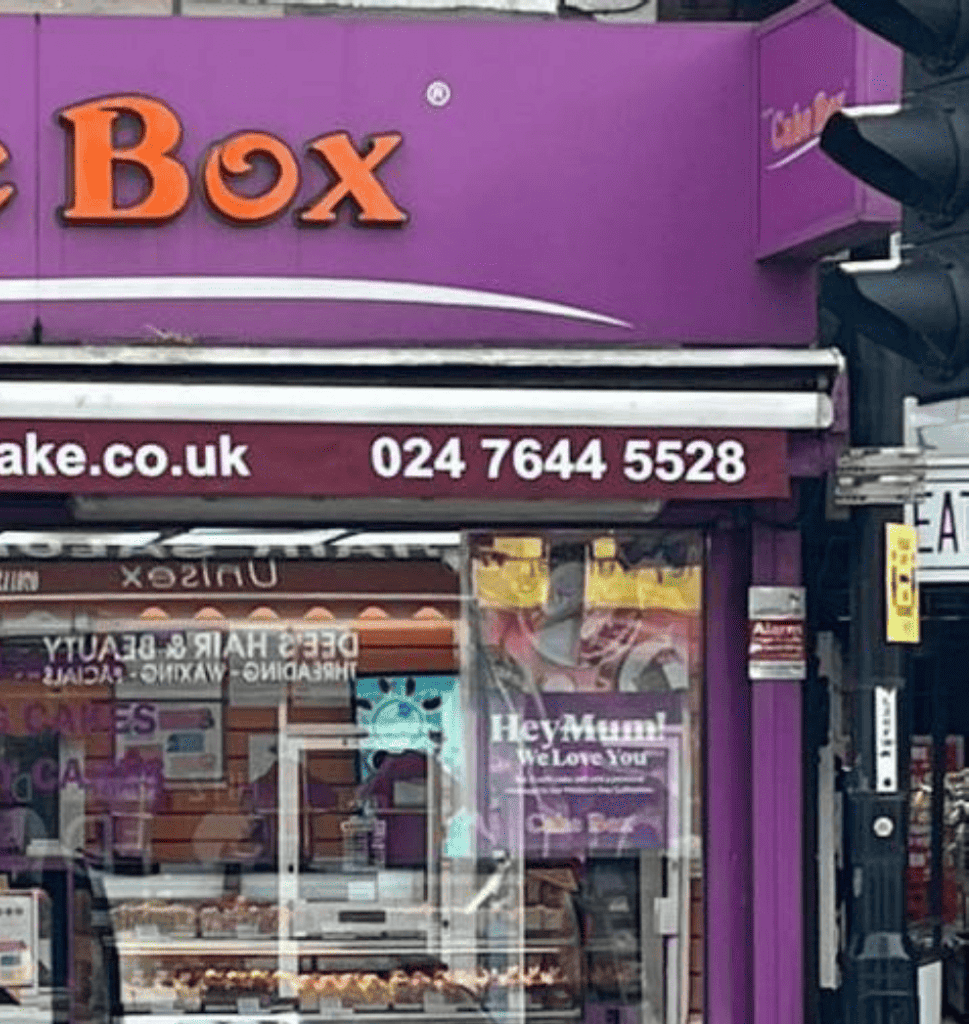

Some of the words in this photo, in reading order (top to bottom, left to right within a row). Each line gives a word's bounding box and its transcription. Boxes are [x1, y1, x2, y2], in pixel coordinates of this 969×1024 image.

[60, 93, 410, 230] Box
[370, 436, 466, 481] 024
[481, 437, 607, 482] 7644
[623, 439, 747, 484] 5528
[914, 491, 969, 553] EA
